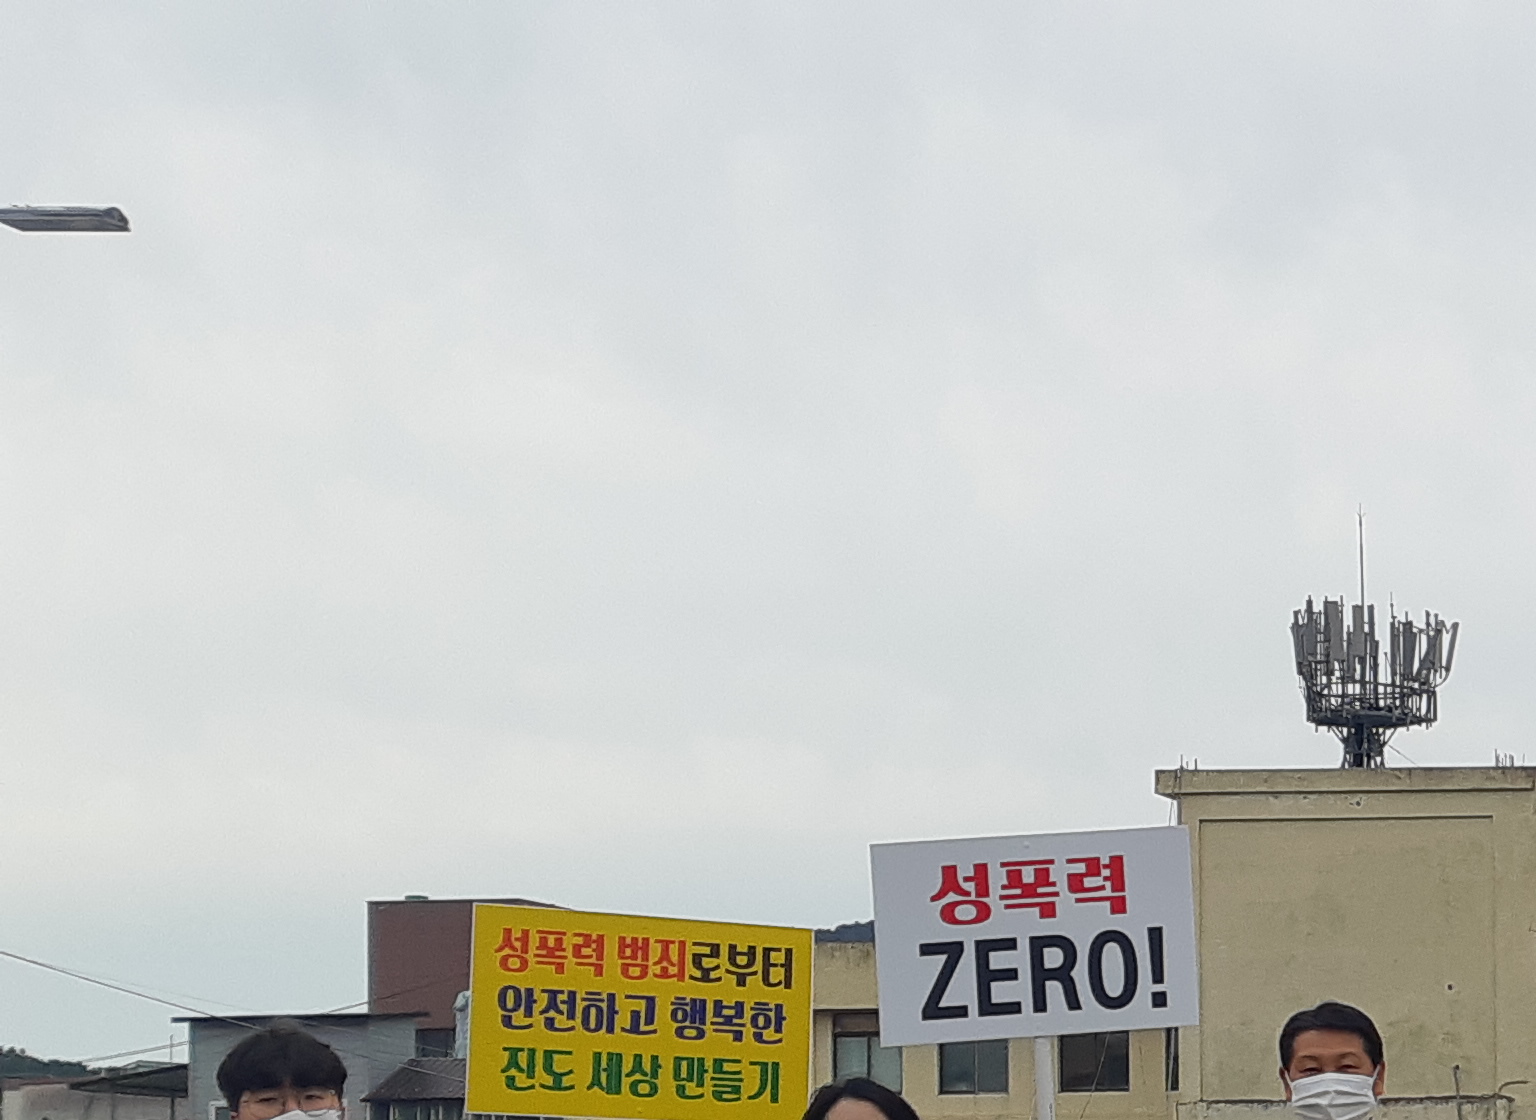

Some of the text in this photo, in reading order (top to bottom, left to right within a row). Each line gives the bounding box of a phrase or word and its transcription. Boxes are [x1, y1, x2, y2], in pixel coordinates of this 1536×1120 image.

[930, 854, 1129, 925] 성폭력
[494, 926, 794, 989] 성폭력 범죄로부터
[919, 926, 1168, 1021] ZERO!
[497, 984, 787, 1044] 안전하고 행복한
[501, 1046, 781, 1103] 진도 세상 만들기
